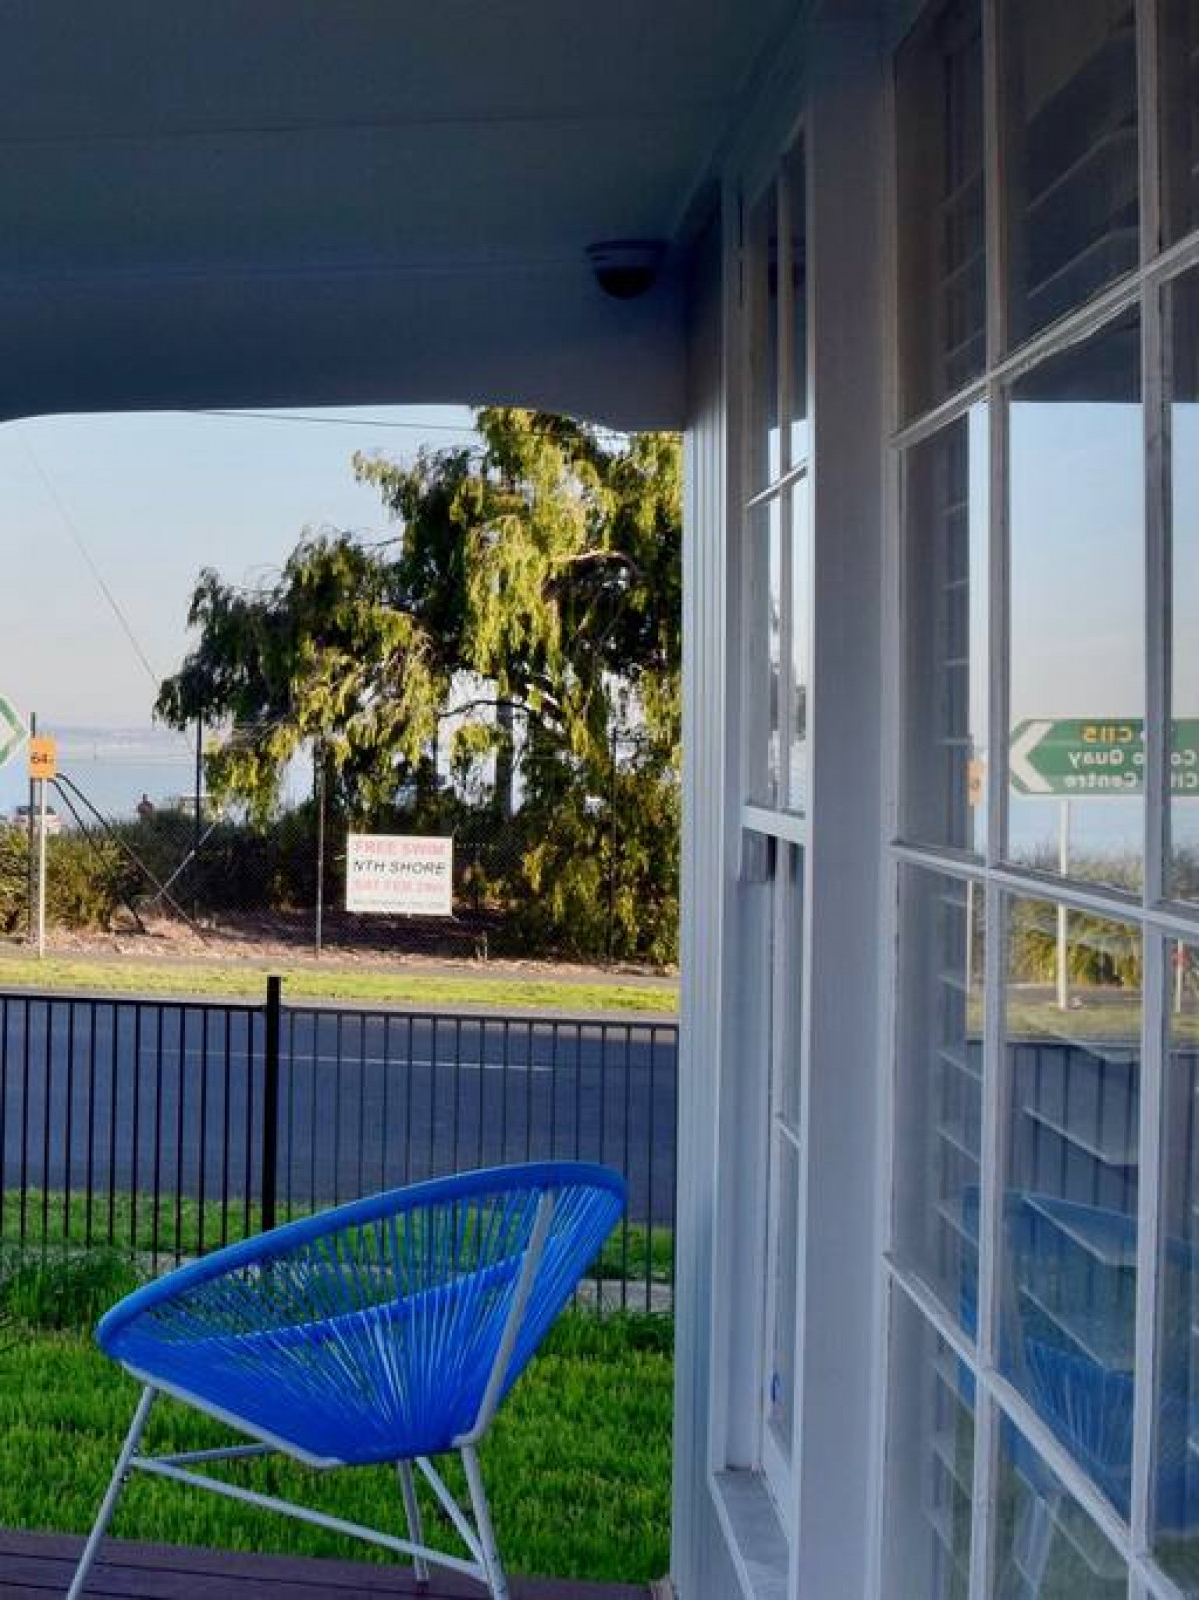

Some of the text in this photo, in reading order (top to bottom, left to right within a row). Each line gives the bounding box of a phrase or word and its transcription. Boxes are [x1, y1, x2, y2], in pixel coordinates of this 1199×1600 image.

[353, 841, 446, 856] FREE SWIM
[353, 861, 446, 876] NTH SHORE
